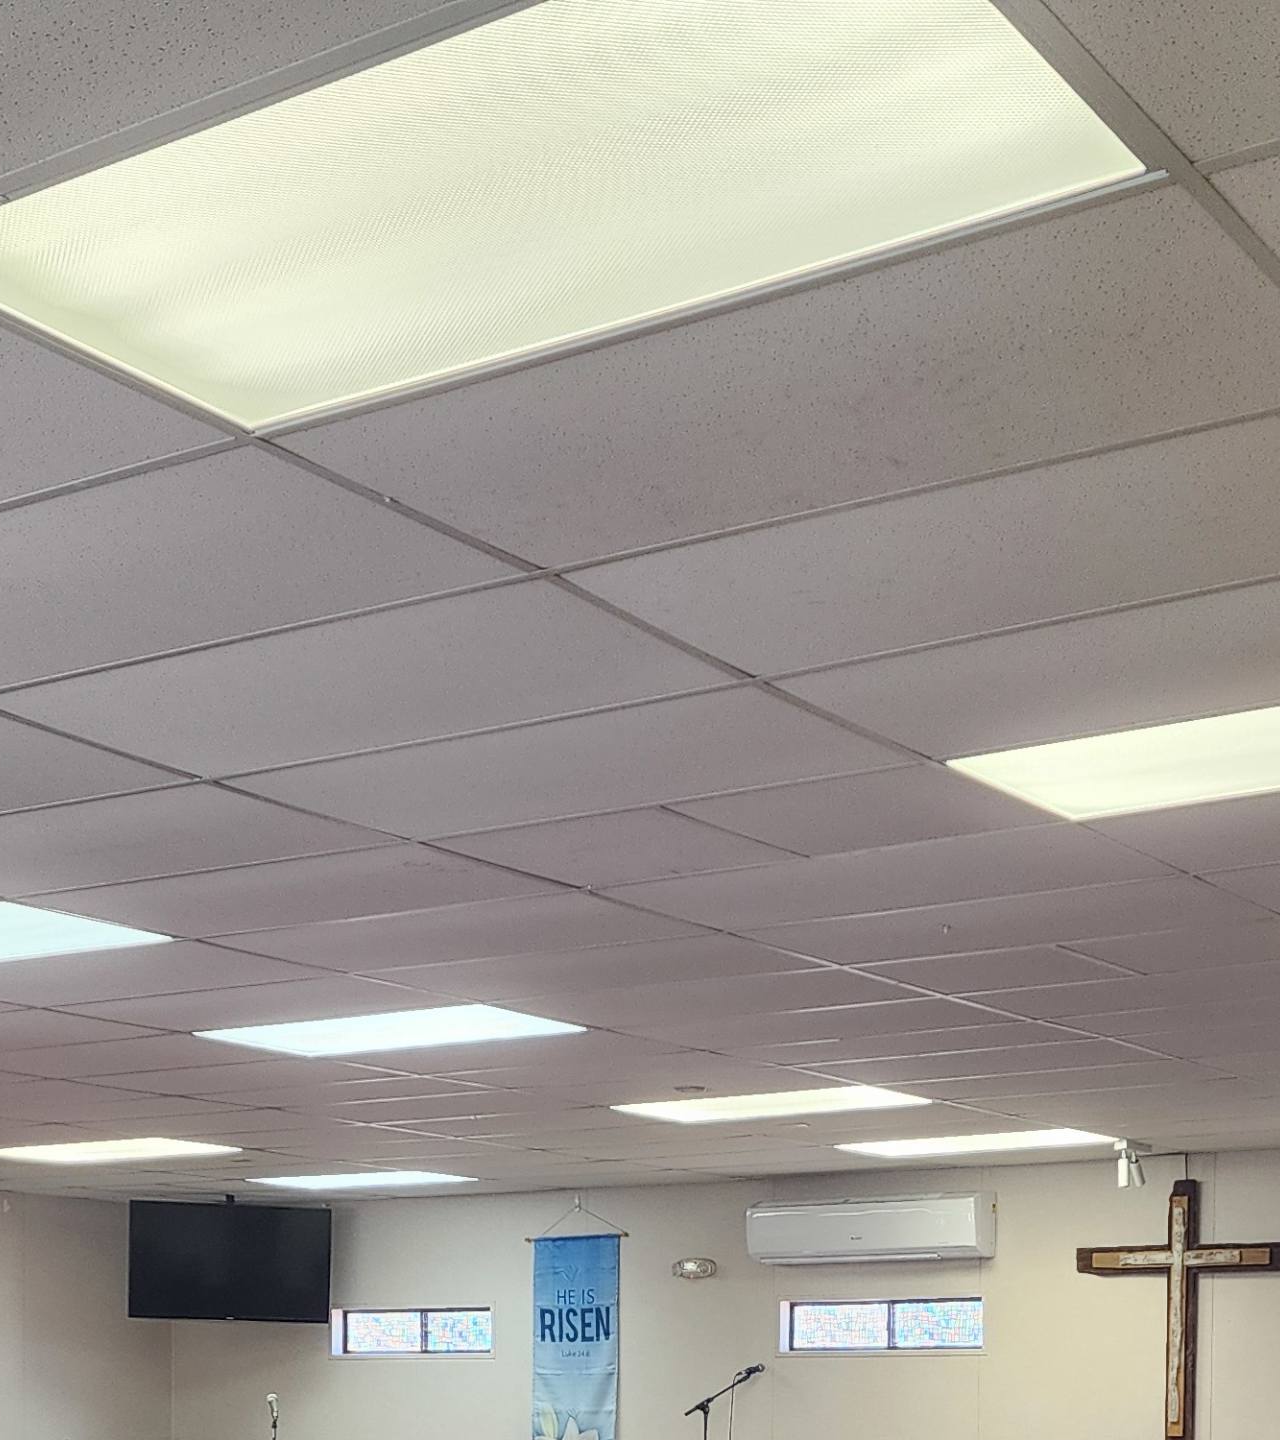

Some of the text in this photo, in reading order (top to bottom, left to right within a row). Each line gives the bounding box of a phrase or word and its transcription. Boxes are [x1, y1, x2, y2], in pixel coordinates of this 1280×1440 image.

[557, 1289, 595, 1305] HE IS
[540, 1306, 610, 1343] RISEN
